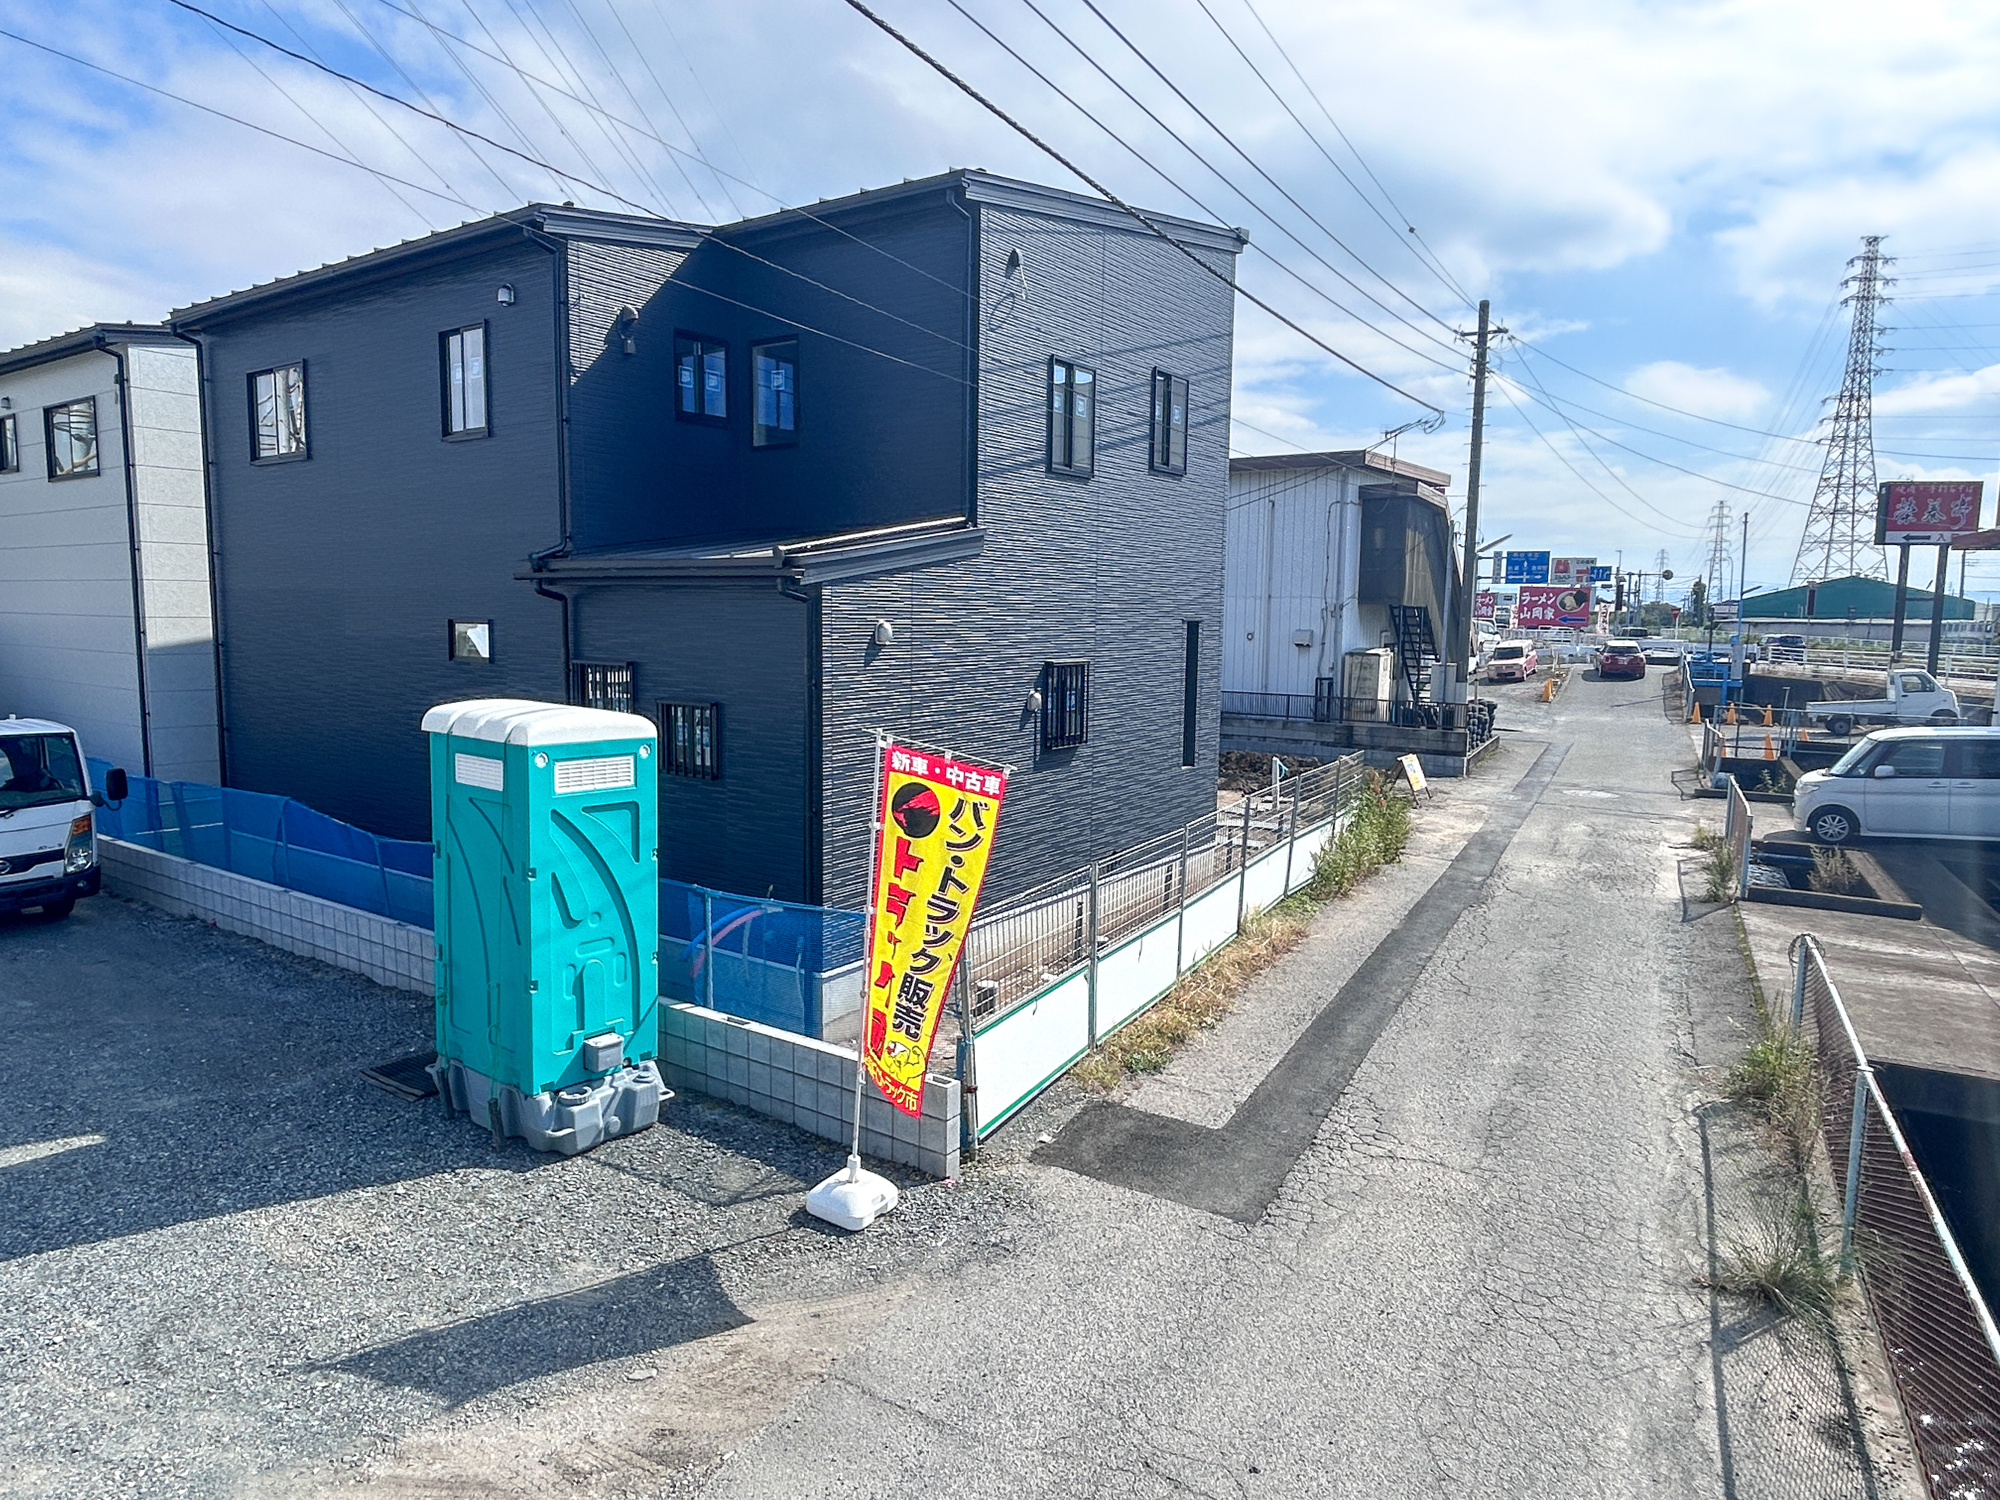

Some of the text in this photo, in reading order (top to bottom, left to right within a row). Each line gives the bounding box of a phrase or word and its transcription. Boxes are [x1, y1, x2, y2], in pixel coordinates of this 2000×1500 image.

[1519, 606, 1555, 620] 山岡家
[1521, 592, 1556, 605] ラーメン
[890, 750, 1002, 796] 新車・中古車
[891, 797, 989, 1041] バン・トラック販売
